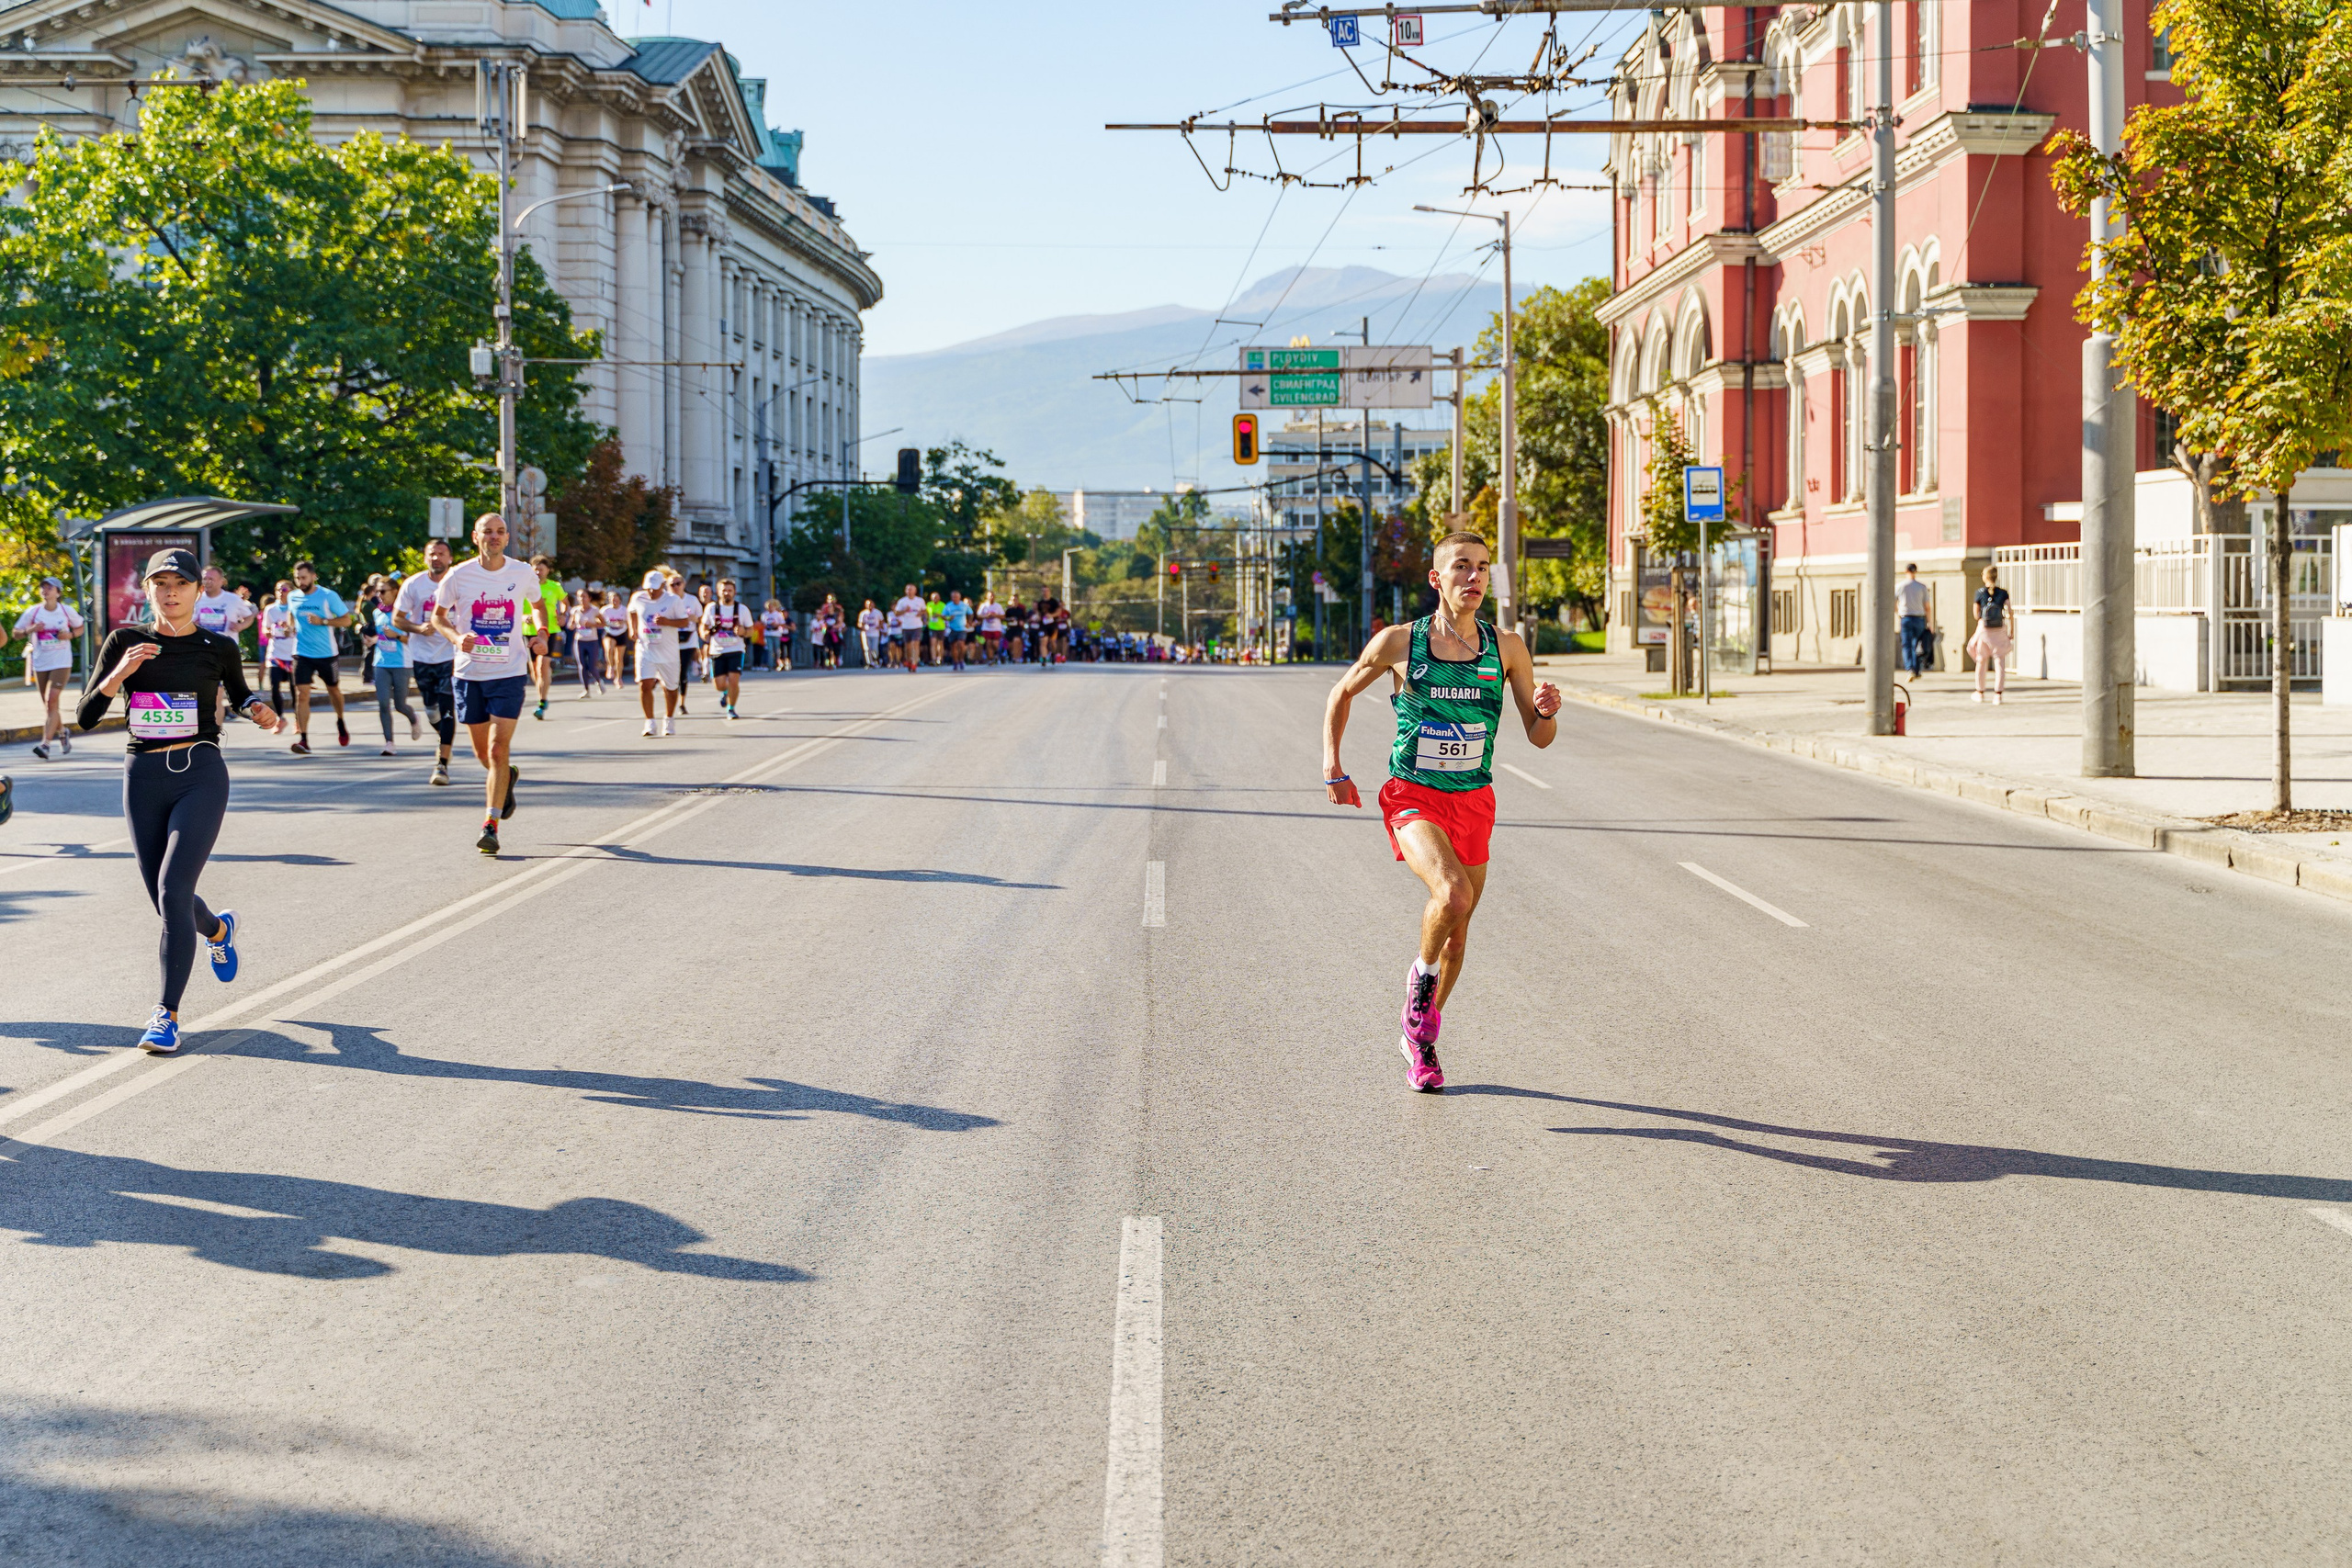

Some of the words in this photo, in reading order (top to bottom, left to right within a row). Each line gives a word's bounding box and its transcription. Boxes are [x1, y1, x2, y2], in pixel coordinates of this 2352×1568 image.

[1399, 20, 1411, 40] 10
[1272, 353, 1318, 364] PLOVDIV
[1273, 392, 1336, 404] SVILENGRAD
[476, 645, 503, 655] 3065
[1430, 687, 1481, 700] BULGARIA
[141, 711, 184, 722] 4535
[1420, 726, 1454, 738] Fibank
[1438, 742, 1468, 756] 561
